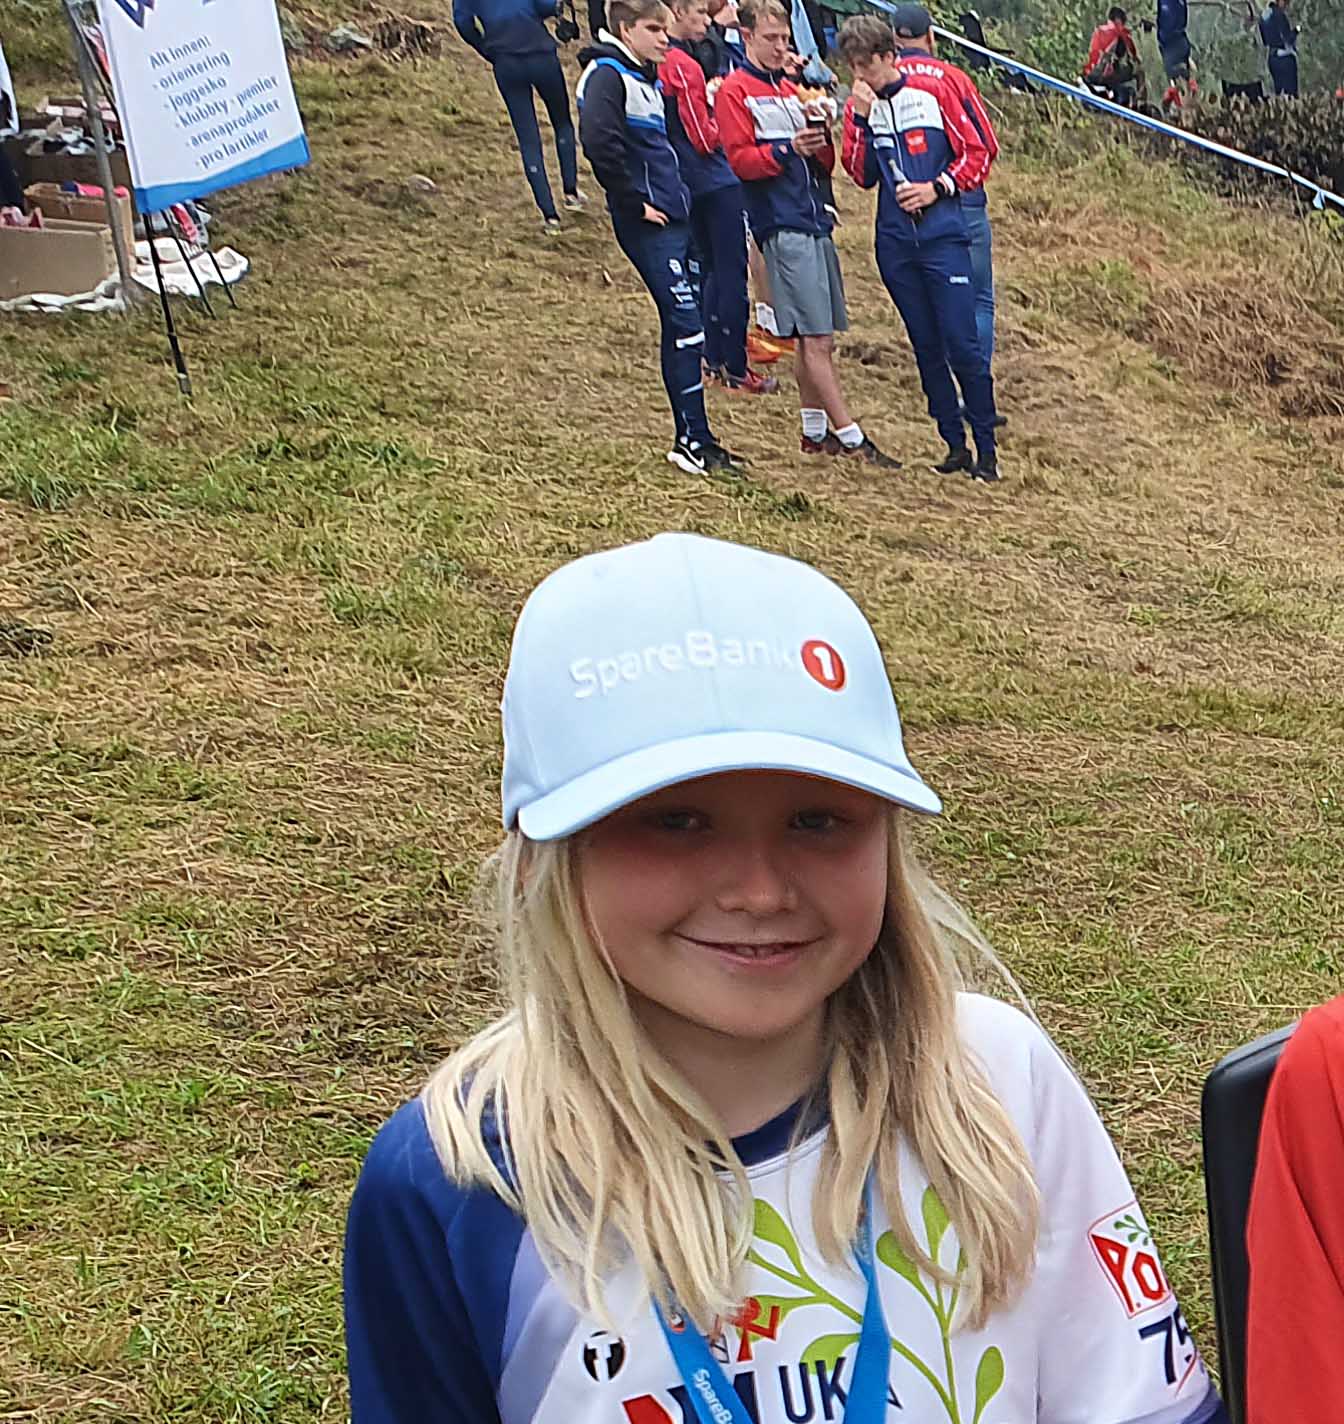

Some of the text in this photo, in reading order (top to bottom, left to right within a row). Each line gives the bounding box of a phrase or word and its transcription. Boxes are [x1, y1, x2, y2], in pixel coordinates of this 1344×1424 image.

[899, 62, 944, 79] ALDEN
[568, 630, 835, 699] SpareBank 1
